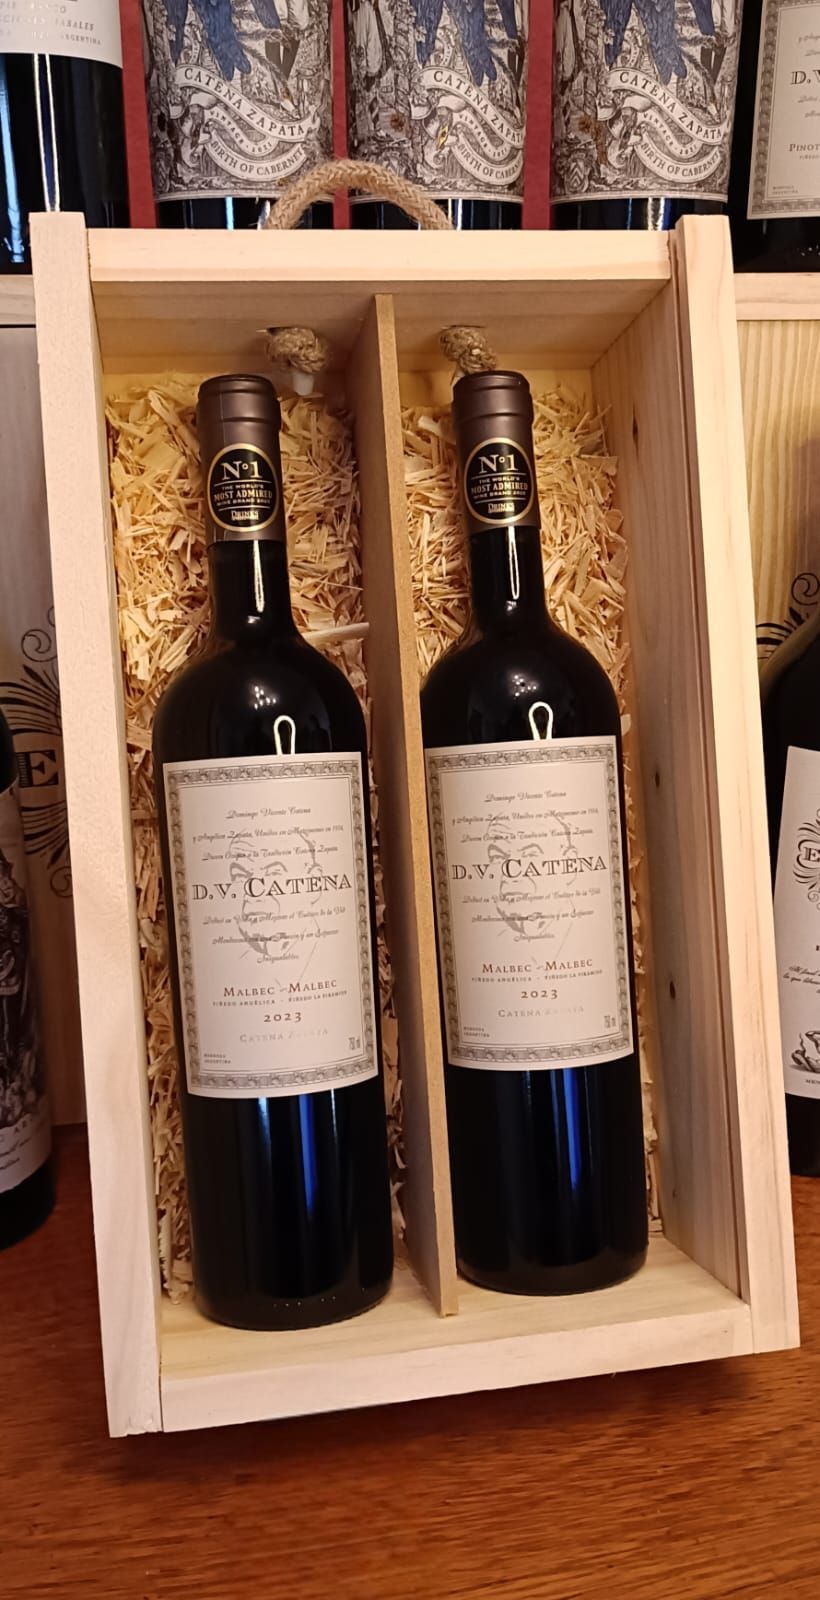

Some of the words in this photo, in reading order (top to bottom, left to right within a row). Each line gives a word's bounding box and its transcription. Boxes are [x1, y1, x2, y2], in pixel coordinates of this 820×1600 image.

[184, 68, 244, 109] CATENA
[246, 109, 305, 136] ZAPATA
[433, 70, 488, 114] CATENA
[491, 115, 523, 143] ZAPAT
[619, 72, 676, 113] CATENA
[679, 112, 721, 140] ZAPATA
[209, 109, 244, 144] VINTAGE
[643, 112, 674, 145] VINTAGE
[211, 140, 238, 170] BIRTH
[239, 163, 254, 173] OF
[256, 148, 303, 175] CABERNET
[458, 143, 481, 170] BIRTH
[482, 166, 494, 176] OF
[641, 141, 665, 169] BIRTH
[667, 164, 680, 175] OF
[681, 151, 719, 177] CABERNET
[214, 491, 234, 501] MOST
[236, 489, 272, 498] ADMIRED
[471, 484, 491, 494] MOST
[493, 481, 528, 491] ADMIRED
[452, 864, 495, 880] D.V.
[501, 856, 608, 878] CATENA
[192, 883, 237, 900] D.V.
[243, 874, 352, 898] CATENA
[482, 963, 532, 974] MALBEC
[544, 958, 593, 971] MALBEC
[223, 986, 275, 997] MALBEC
[287, 979, 337, 993] MALBEC
[521, 989, 558, 1000] 2023
[263, 1011, 302, 1023] 2023
[498, 1009, 541, 1018] CATENA
[239, 1033, 283, 1043] CATENA
